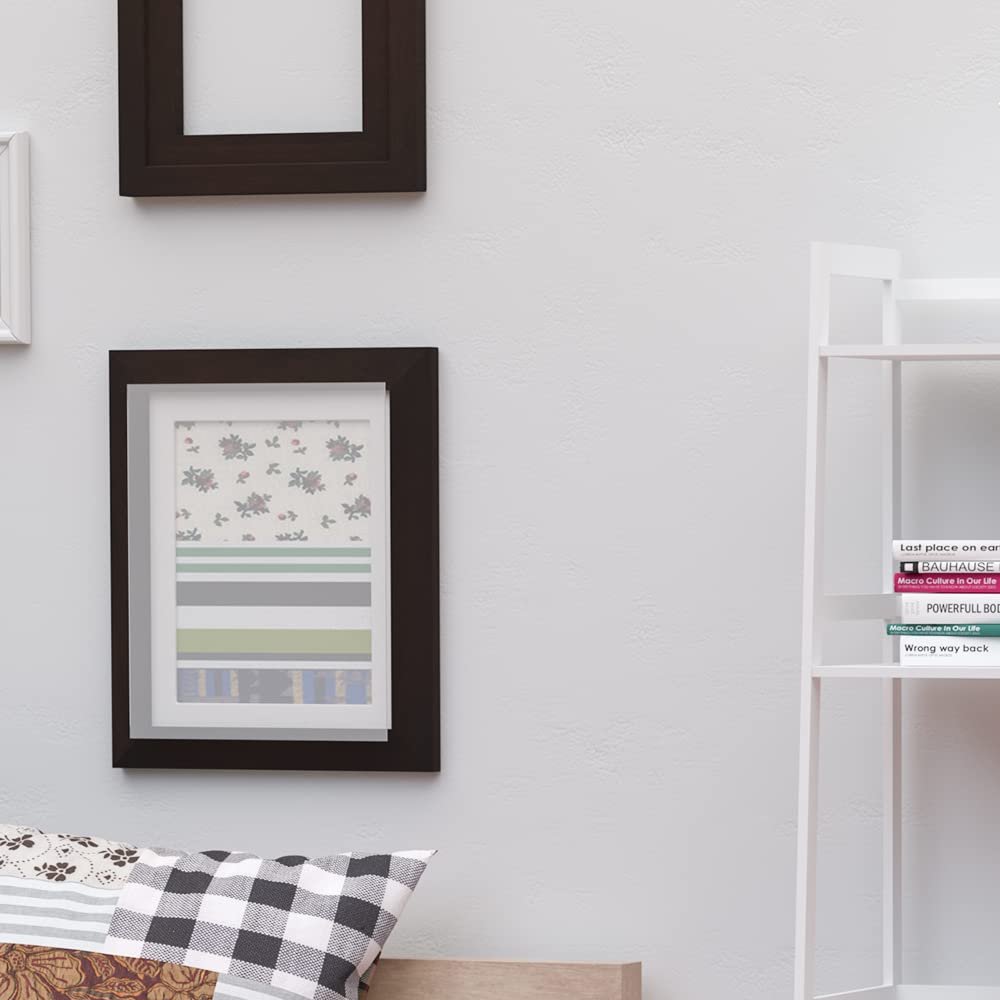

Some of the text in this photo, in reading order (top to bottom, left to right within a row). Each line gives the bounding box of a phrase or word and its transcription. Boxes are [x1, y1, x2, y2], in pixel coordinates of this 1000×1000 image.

[900, 543, 922, 552] Last
[925, 543, 959, 553] place
[921, 561, 994, 572] BAUHAUSE
[897, 577, 925, 585] Macro
[925, 577, 955, 585] Culture
[966, 577, 981, 585] Our
[983, 577, 997, 585] Life
[926, 603, 982, 614] POWERFULL
[904, 644, 989, 654] Wrong way back
